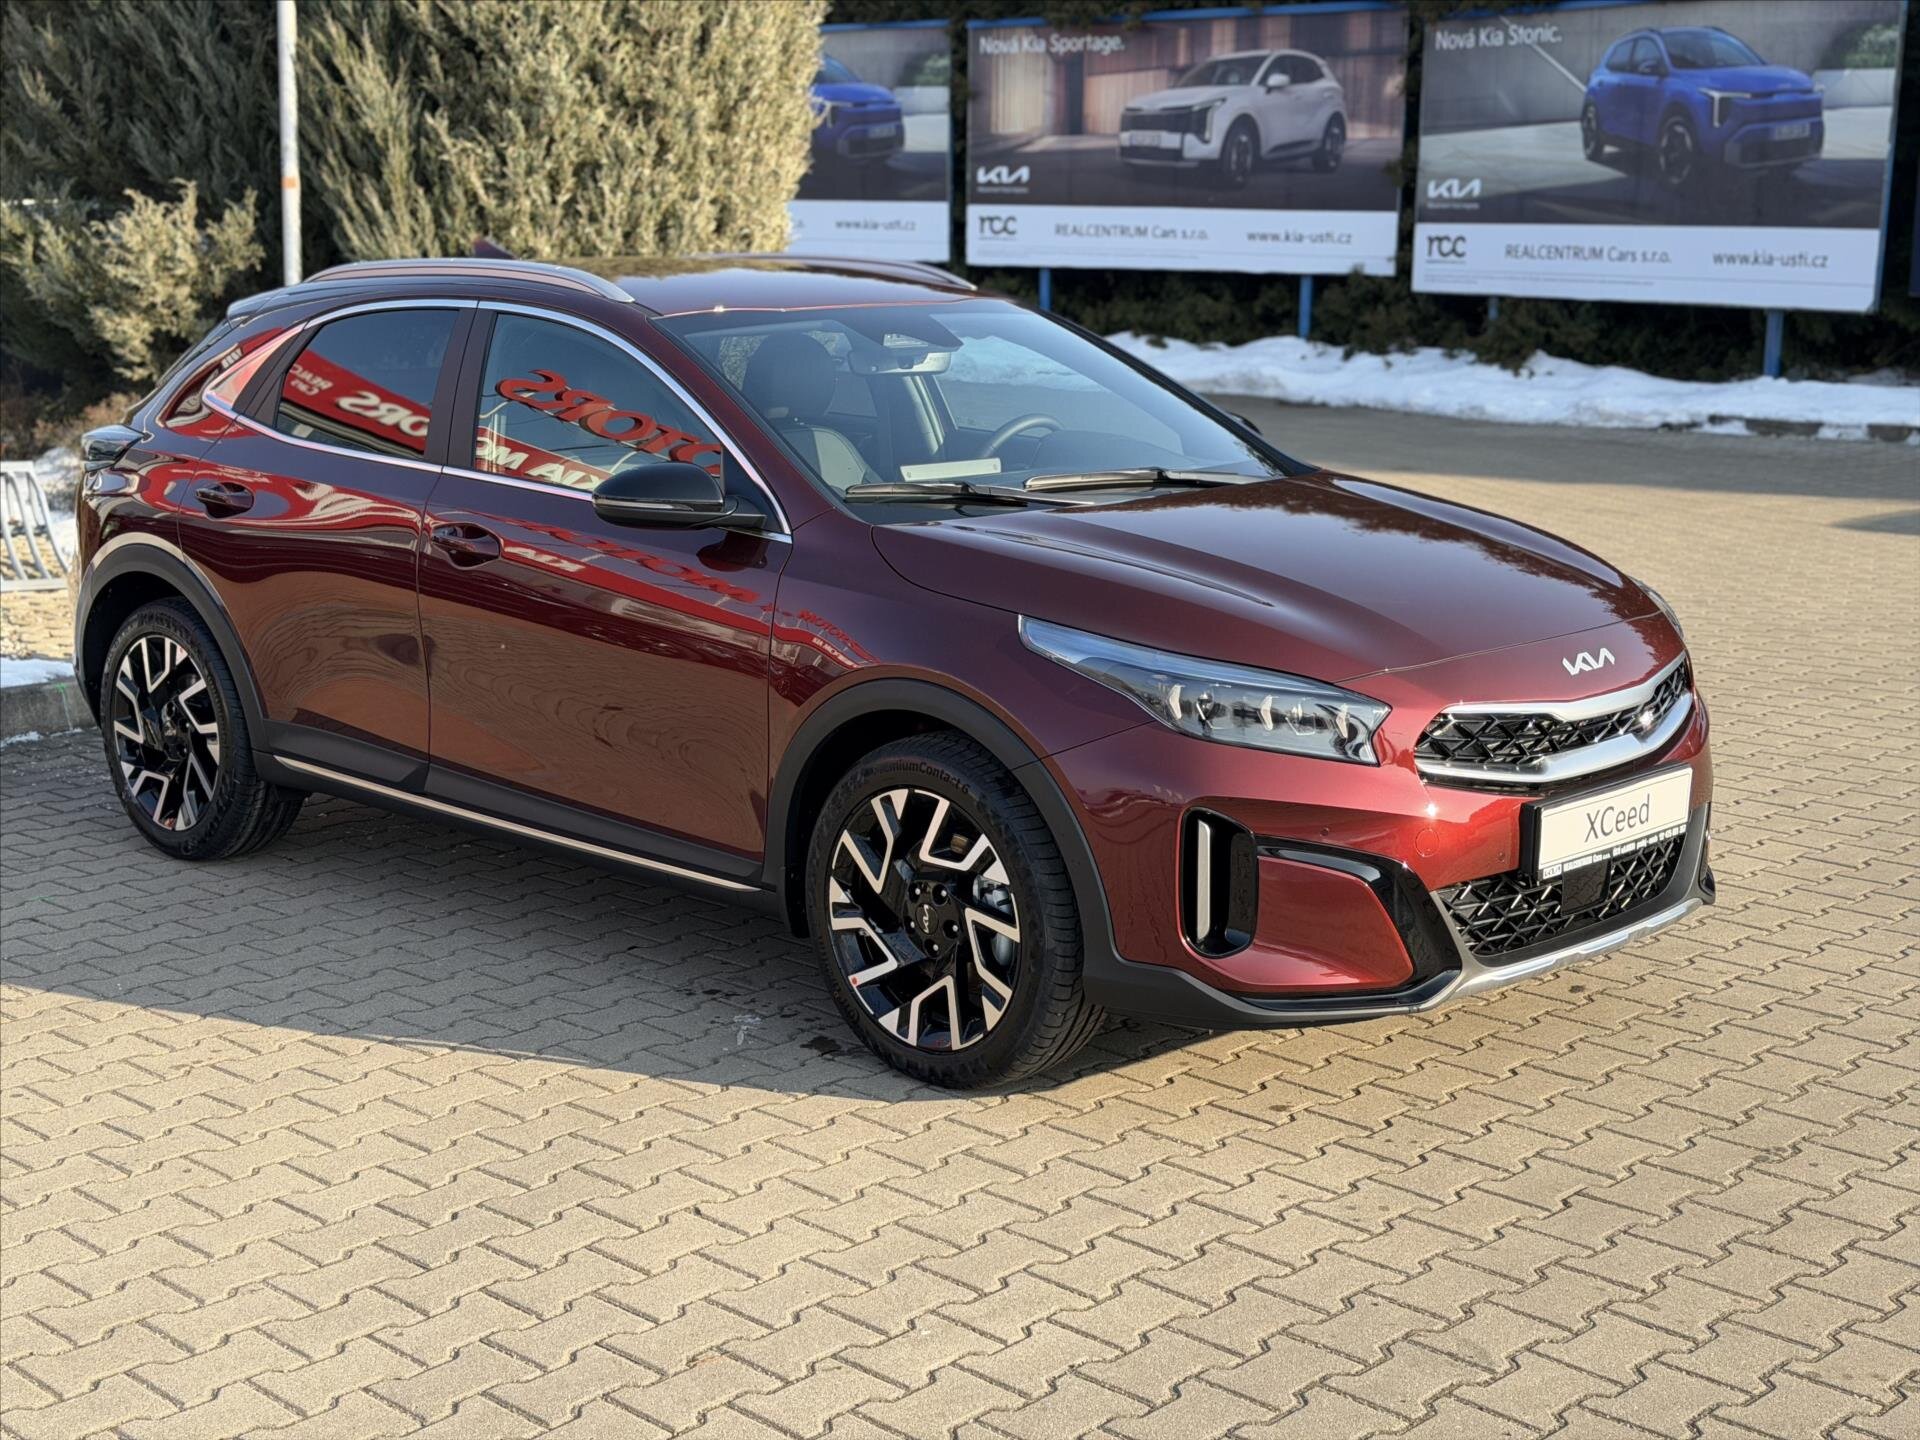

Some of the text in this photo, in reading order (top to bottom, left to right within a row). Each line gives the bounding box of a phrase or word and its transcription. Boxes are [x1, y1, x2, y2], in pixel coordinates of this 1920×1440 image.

[1021, 30, 1047, 53] Kia
[1050, 33, 1126, 55] Sportage.
[1478, 26, 1504, 47] Kia
[1507, 22, 1563, 46] Stonic.
[976, 165, 1031, 184] KIA
[1426, 178, 1482, 198] KIA
[1055, 223, 1149, 238] REALCENTRUM
[1152, 225, 1178, 240] Cars
[1504, 244, 1672, 264] REALCENTRUM Cars s.r.o.
[1712, 249, 1829, 268] www.kia-usti.cz
[1562, 647, 1615, 676] KIA
[1584, 793, 1650, 843] XCeed
